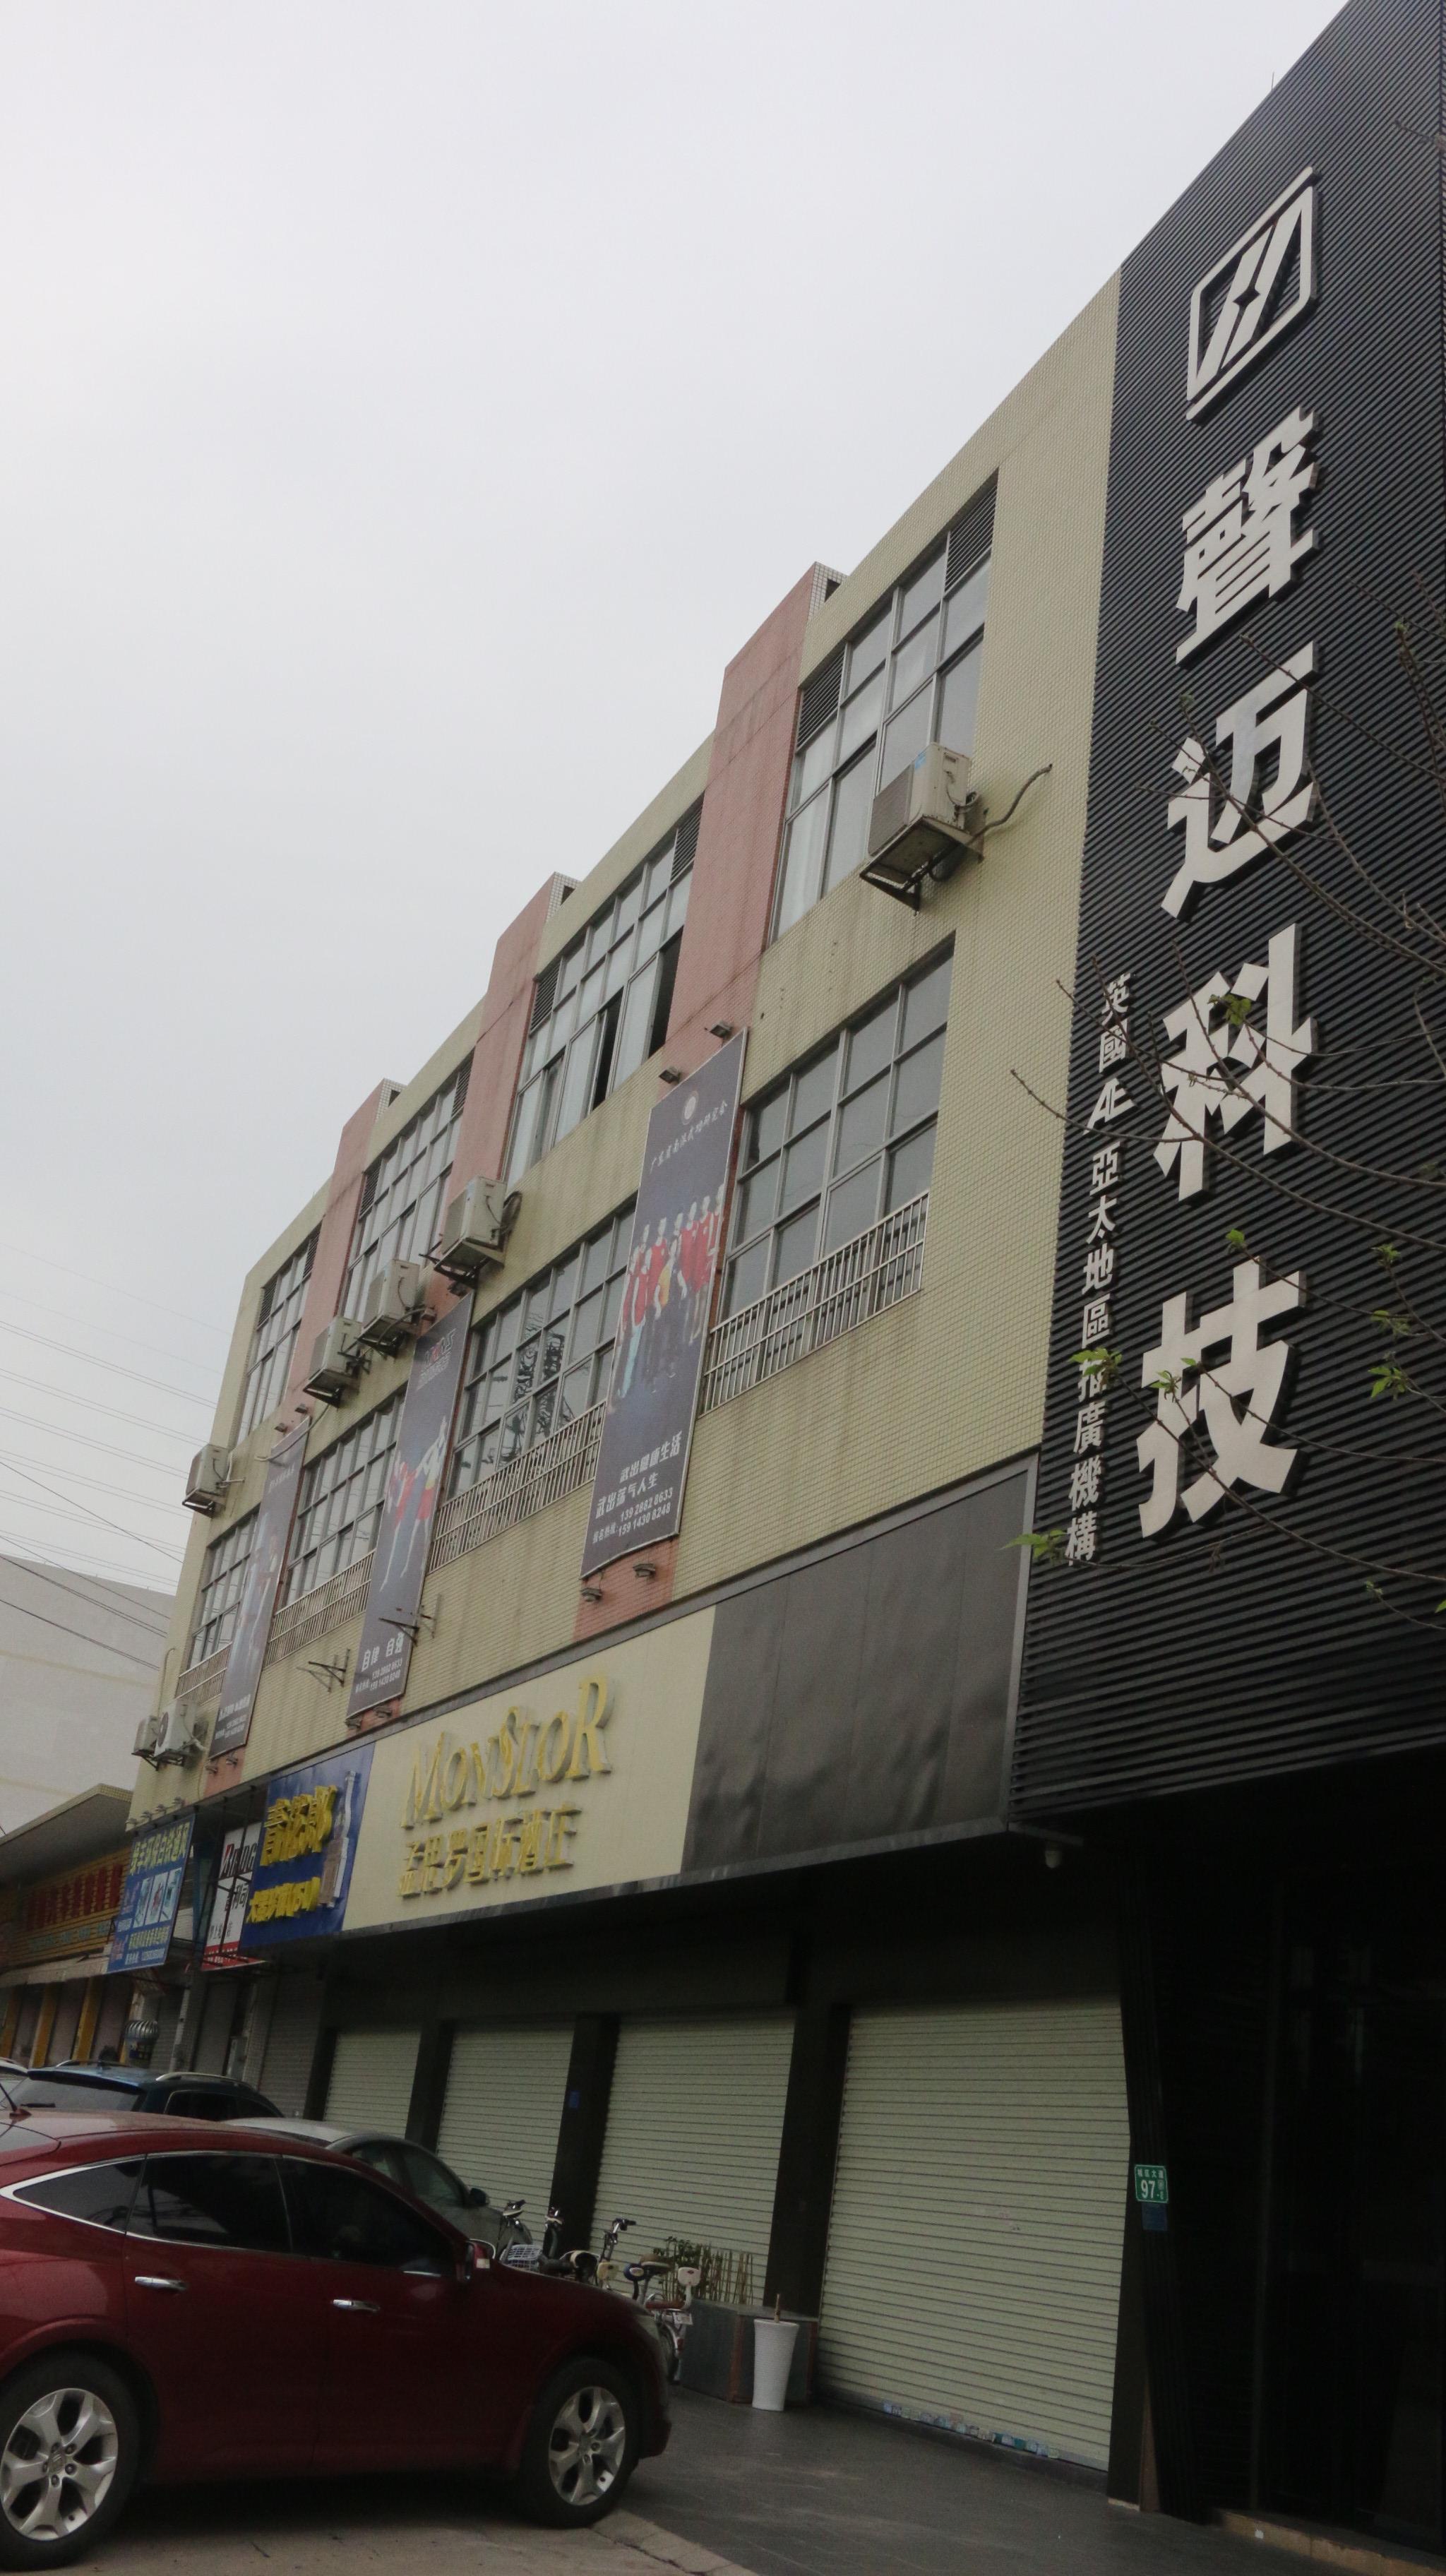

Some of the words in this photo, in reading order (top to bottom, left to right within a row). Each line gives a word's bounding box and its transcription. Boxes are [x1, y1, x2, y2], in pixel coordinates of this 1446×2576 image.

[618, 1523, 632, 1538] 159
[633, 1514, 650, 1532] 1430
[652, 1502, 671, 1520] 8248
[621, 1507, 634, 1522] 139
[654, 1487, 673, 1505] 8633
